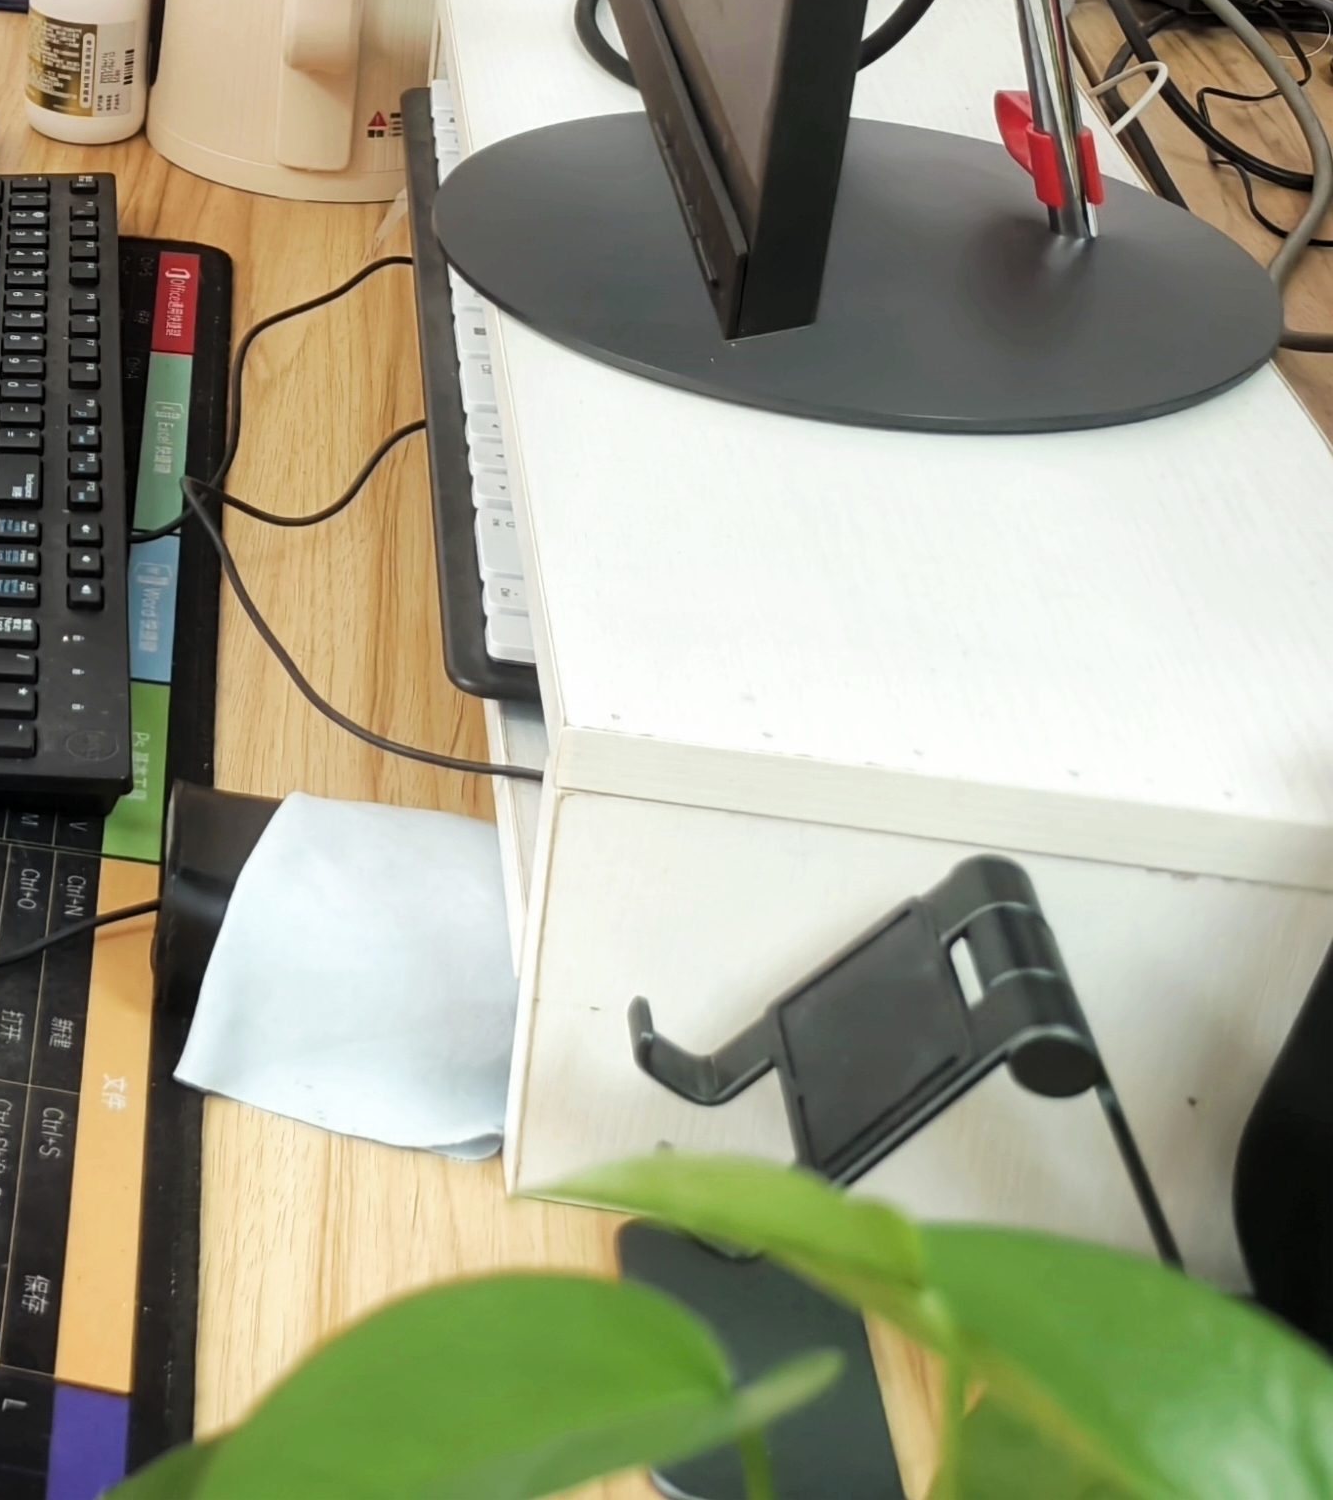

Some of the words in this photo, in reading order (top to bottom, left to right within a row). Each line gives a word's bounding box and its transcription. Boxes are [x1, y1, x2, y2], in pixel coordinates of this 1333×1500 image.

[164, 279, 182, 337] Office通用快捷键
[156, 422, 174, 445] Excel
[140, 587, 160, 617] Word
[132, 731, 151, 747] Ps
[20, 813, 39, 826] M
[68, 821, 88, 832] V
[16, 867, 41, 910] Ctrl+O
[63, 874, 87, 916] Ctrl+N
[48, 1016, 74, 1049] 新建
[101, 1073, 126, 1111] 文件
[38, 1106, 65, 1159] Ctrl+S
[21, 1274, 51, 1315] 保存
[0, 1397, 29, 1412] L
